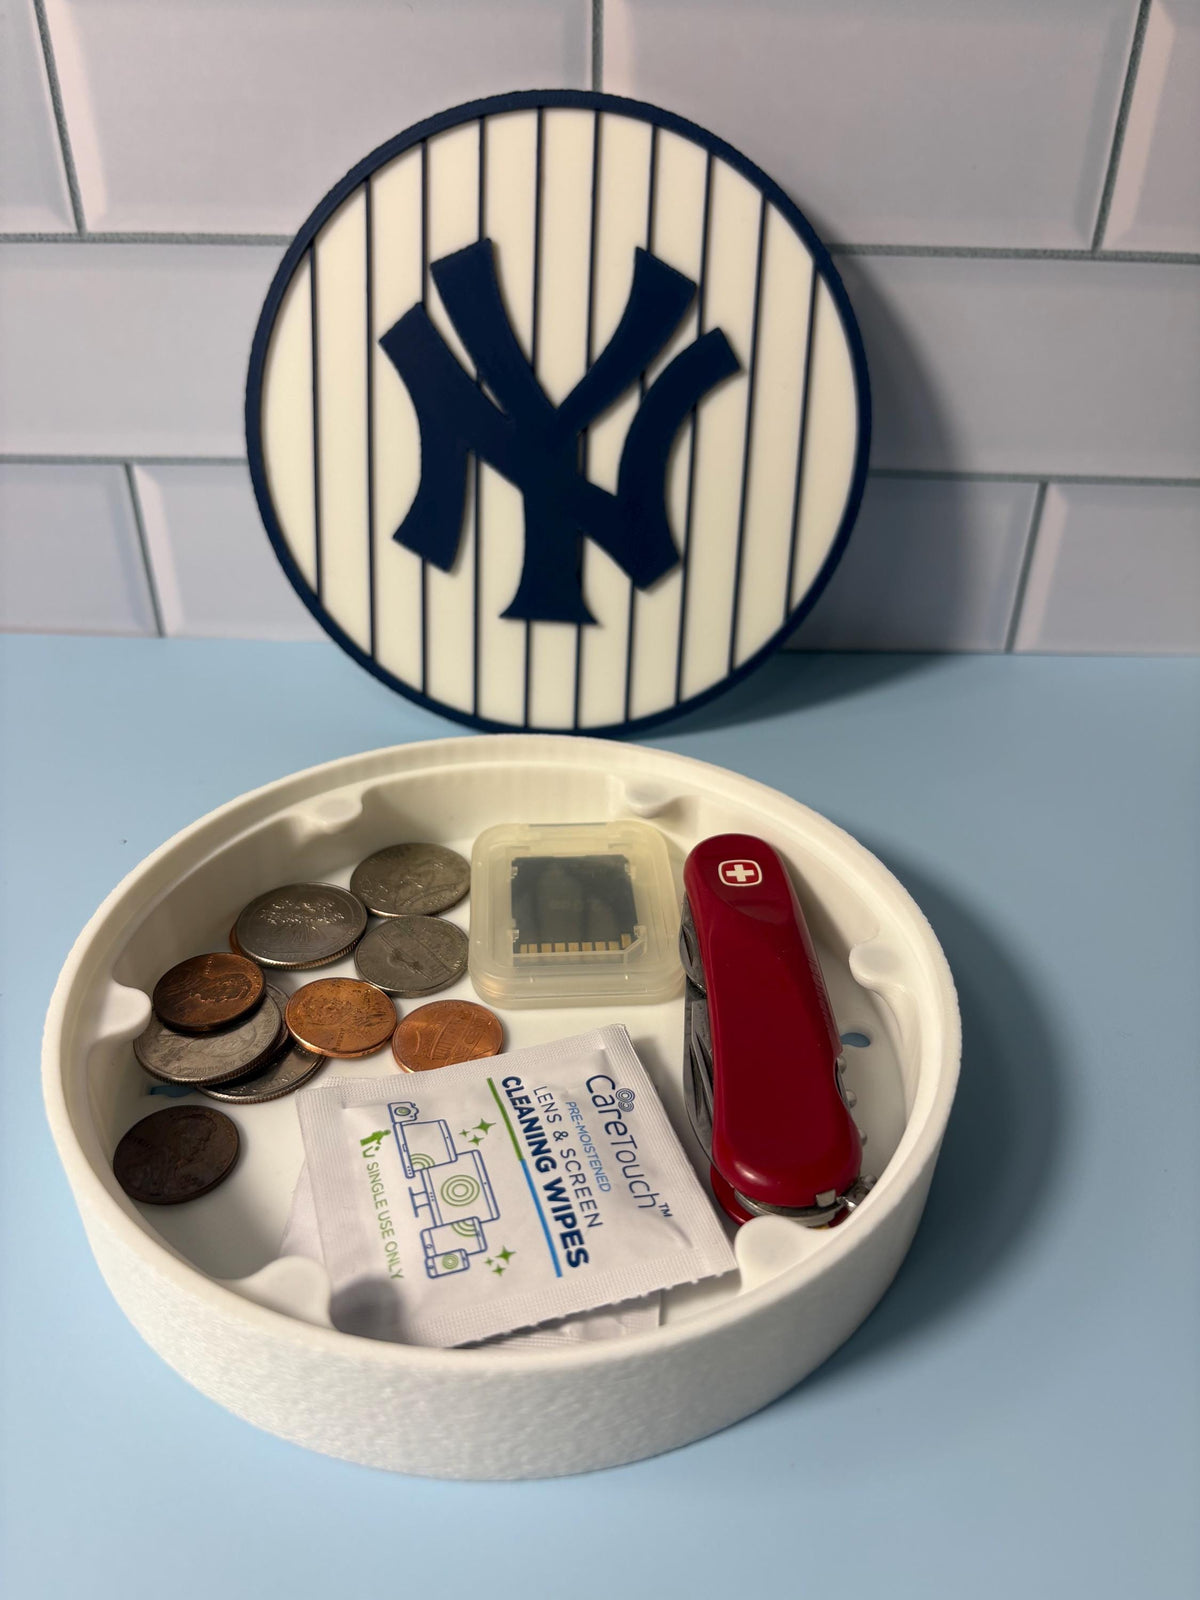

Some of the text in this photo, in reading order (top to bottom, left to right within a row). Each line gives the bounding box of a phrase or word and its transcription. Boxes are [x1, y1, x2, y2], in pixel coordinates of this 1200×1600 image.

[501, 1076, 590, 1268] CLEANING WIPES
[533, 1085, 604, 1229] LENS & SCREEN
[566, 1101, 611, 1193] PRE-MOISTENED
[366, 1161, 405, 1280] SINGLE USE ONLY
